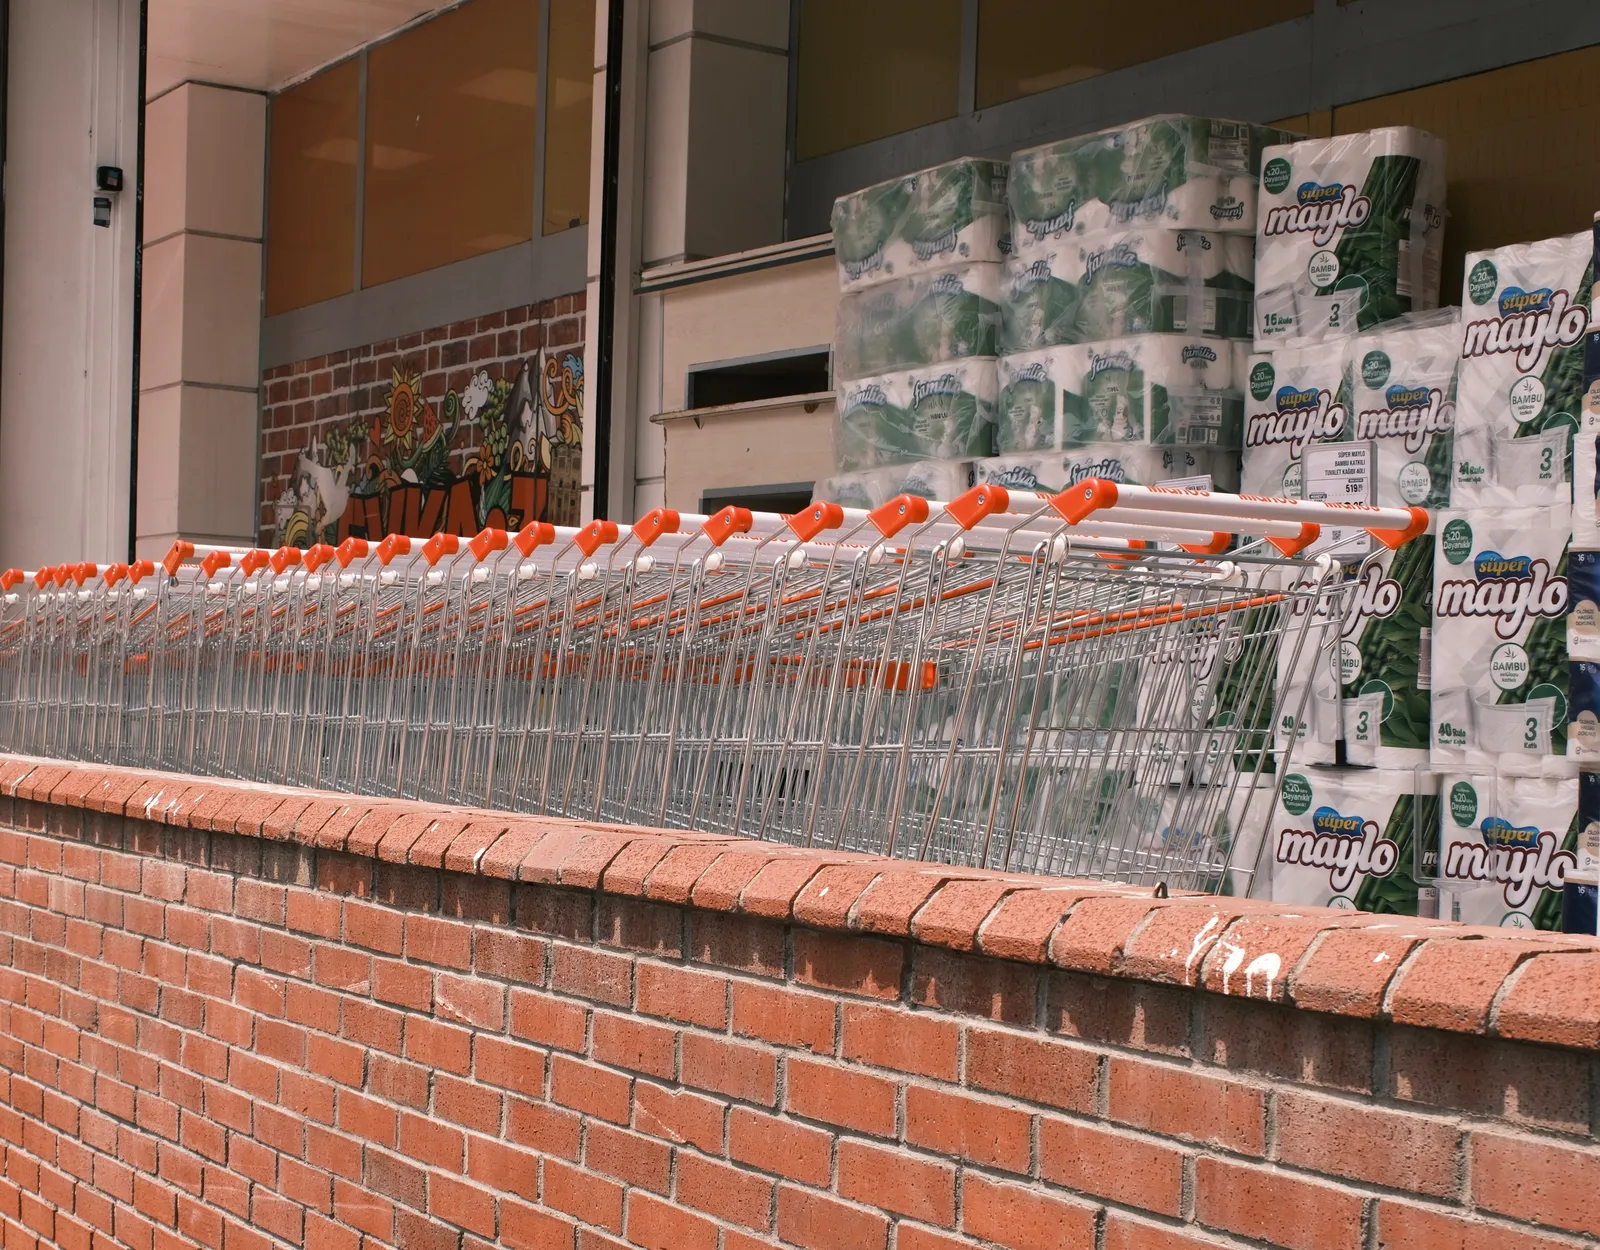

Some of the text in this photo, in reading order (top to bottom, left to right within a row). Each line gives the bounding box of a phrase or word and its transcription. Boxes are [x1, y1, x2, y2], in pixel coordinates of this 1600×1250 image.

[1301, 186, 1338, 199] süper
[1264, 184, 1371, 247] maylo
[1311, 264, 1337, 273] BAMBU
[1330, 303, 1340, 321] 3
[1503, 293, 1547, 311] süper
[1264, 313, 1277, 326] 16
[1462, 288, 1590, 373] maylo
[1279, 392, 1315, 407] süper
[1512, 394, 1542, 405] BAMBU
[1246, 388, 1348, 460] maylo
[1357, 388, 1457, 454] maylo
[1540, 447, 1553, 471] 3
[1070, 459, 1125, 485] familia
[1285, 479, 1301, 487] BAM
[1479, 556, 1526, 576] süper
[1436, 558, 1568, 640] maylo
[1493, 661, 1526, 671] BAMBU
[1282, 715, 1294, 729] 40
[1357, 711, 1369, 733] 3
[1438, 723, 1451, 737] 40
[1525, 717, 1538, 741] 3
[1318, 814, 1360, 832] süper
[1487, 824, 1534, 844] süper
[1277, 820, 1399, 892] maylo
[1445, 830, 1577, 908] maylo
